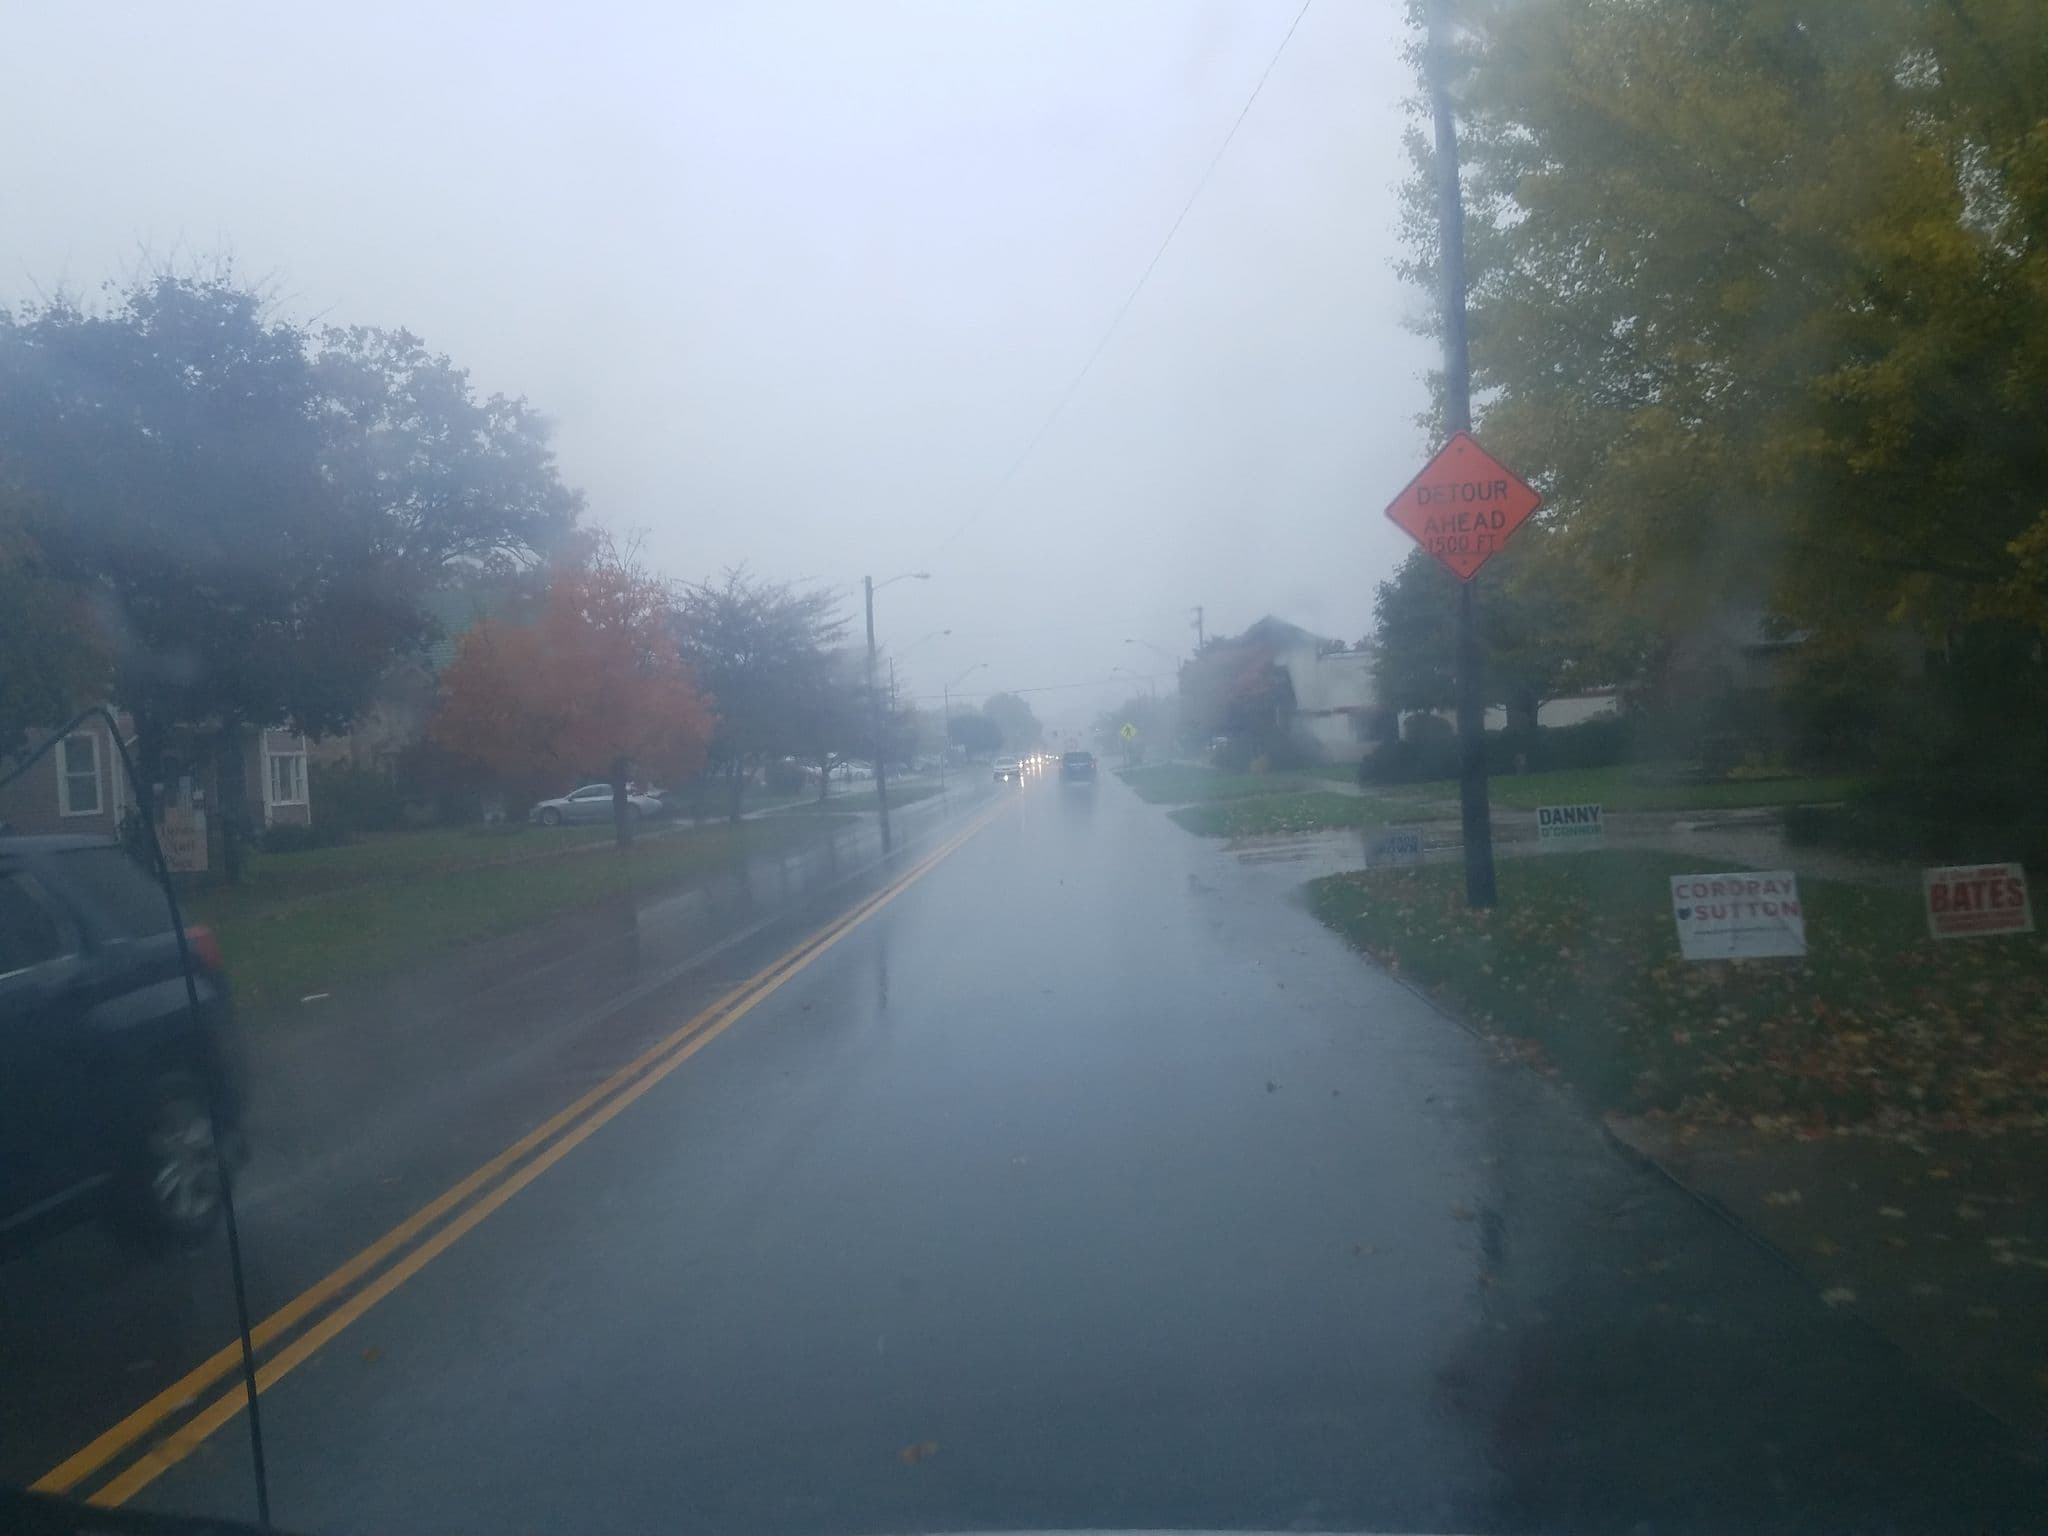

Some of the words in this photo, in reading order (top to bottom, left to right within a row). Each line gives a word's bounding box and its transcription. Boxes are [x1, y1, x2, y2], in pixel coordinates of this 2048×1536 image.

[1418, 481, 1507, 505] DETOUR
[1426, 511, 1504, 534] AHEAD
[1429, 536, 1468, 552] 1500
[1478, 535, 1496, 552] FT
[1539, 806, 1600, 825] DANNY
[1931, 879, 2023, 912] BATES
[1695, 901, 1799, 920] SUTTON
